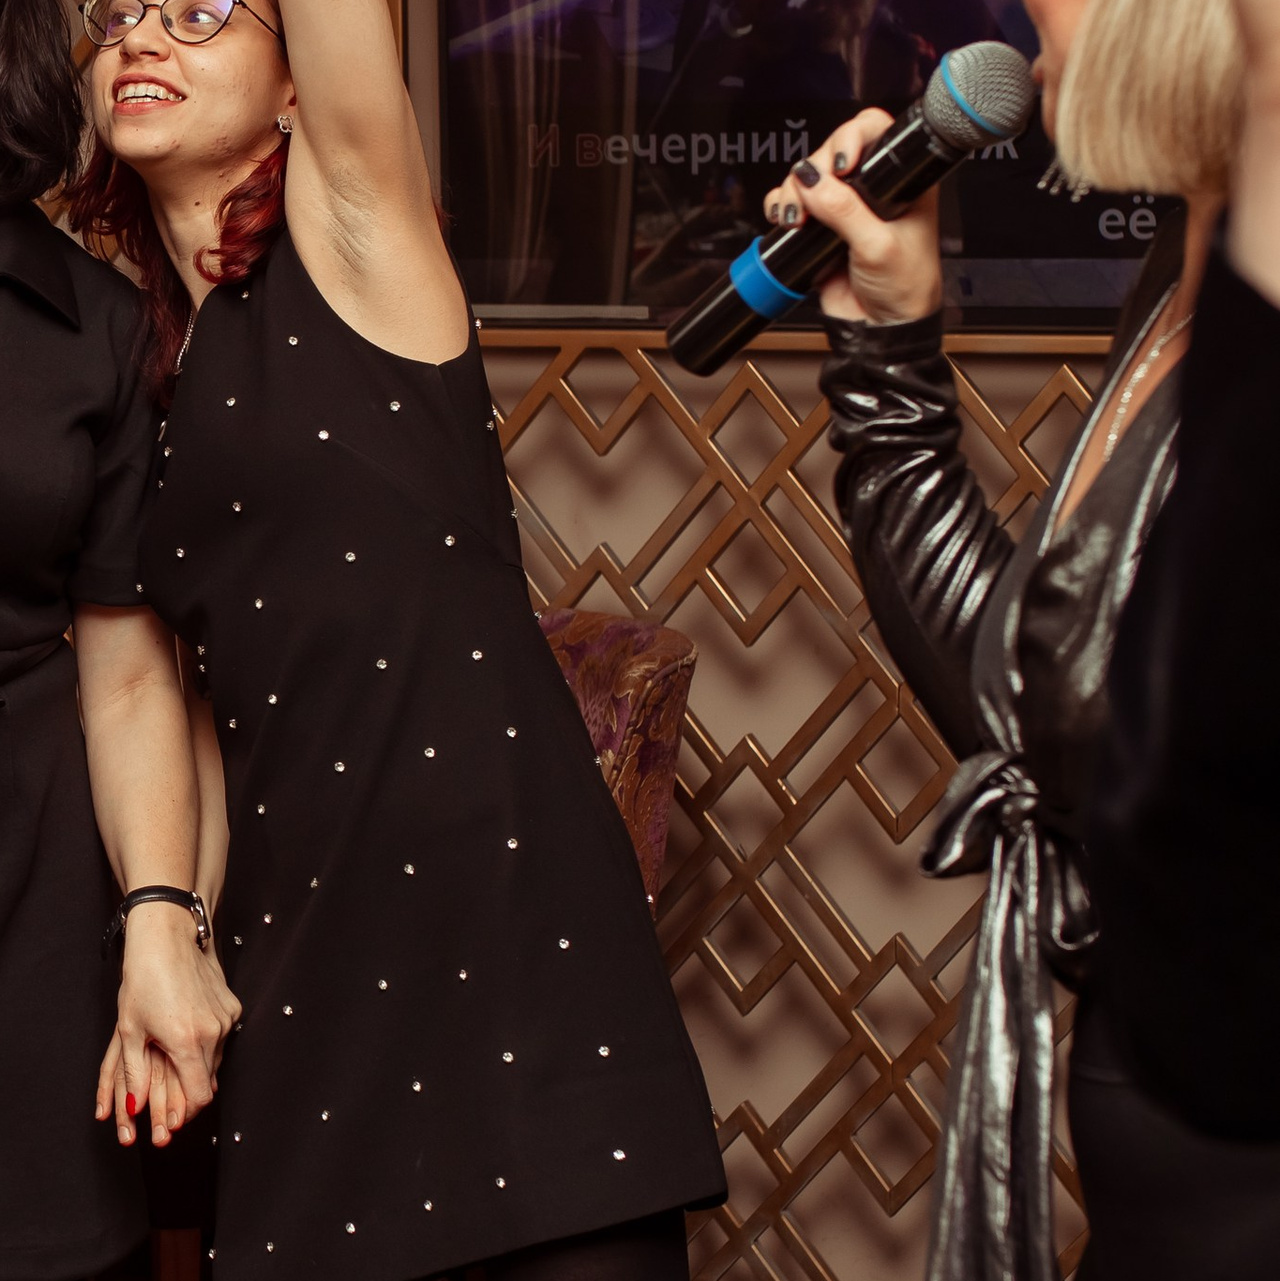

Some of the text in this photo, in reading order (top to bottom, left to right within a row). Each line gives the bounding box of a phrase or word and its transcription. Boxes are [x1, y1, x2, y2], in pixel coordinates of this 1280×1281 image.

[528, 119, 810, 175] И вечерний
[1098, 195, 1157, 240] её
